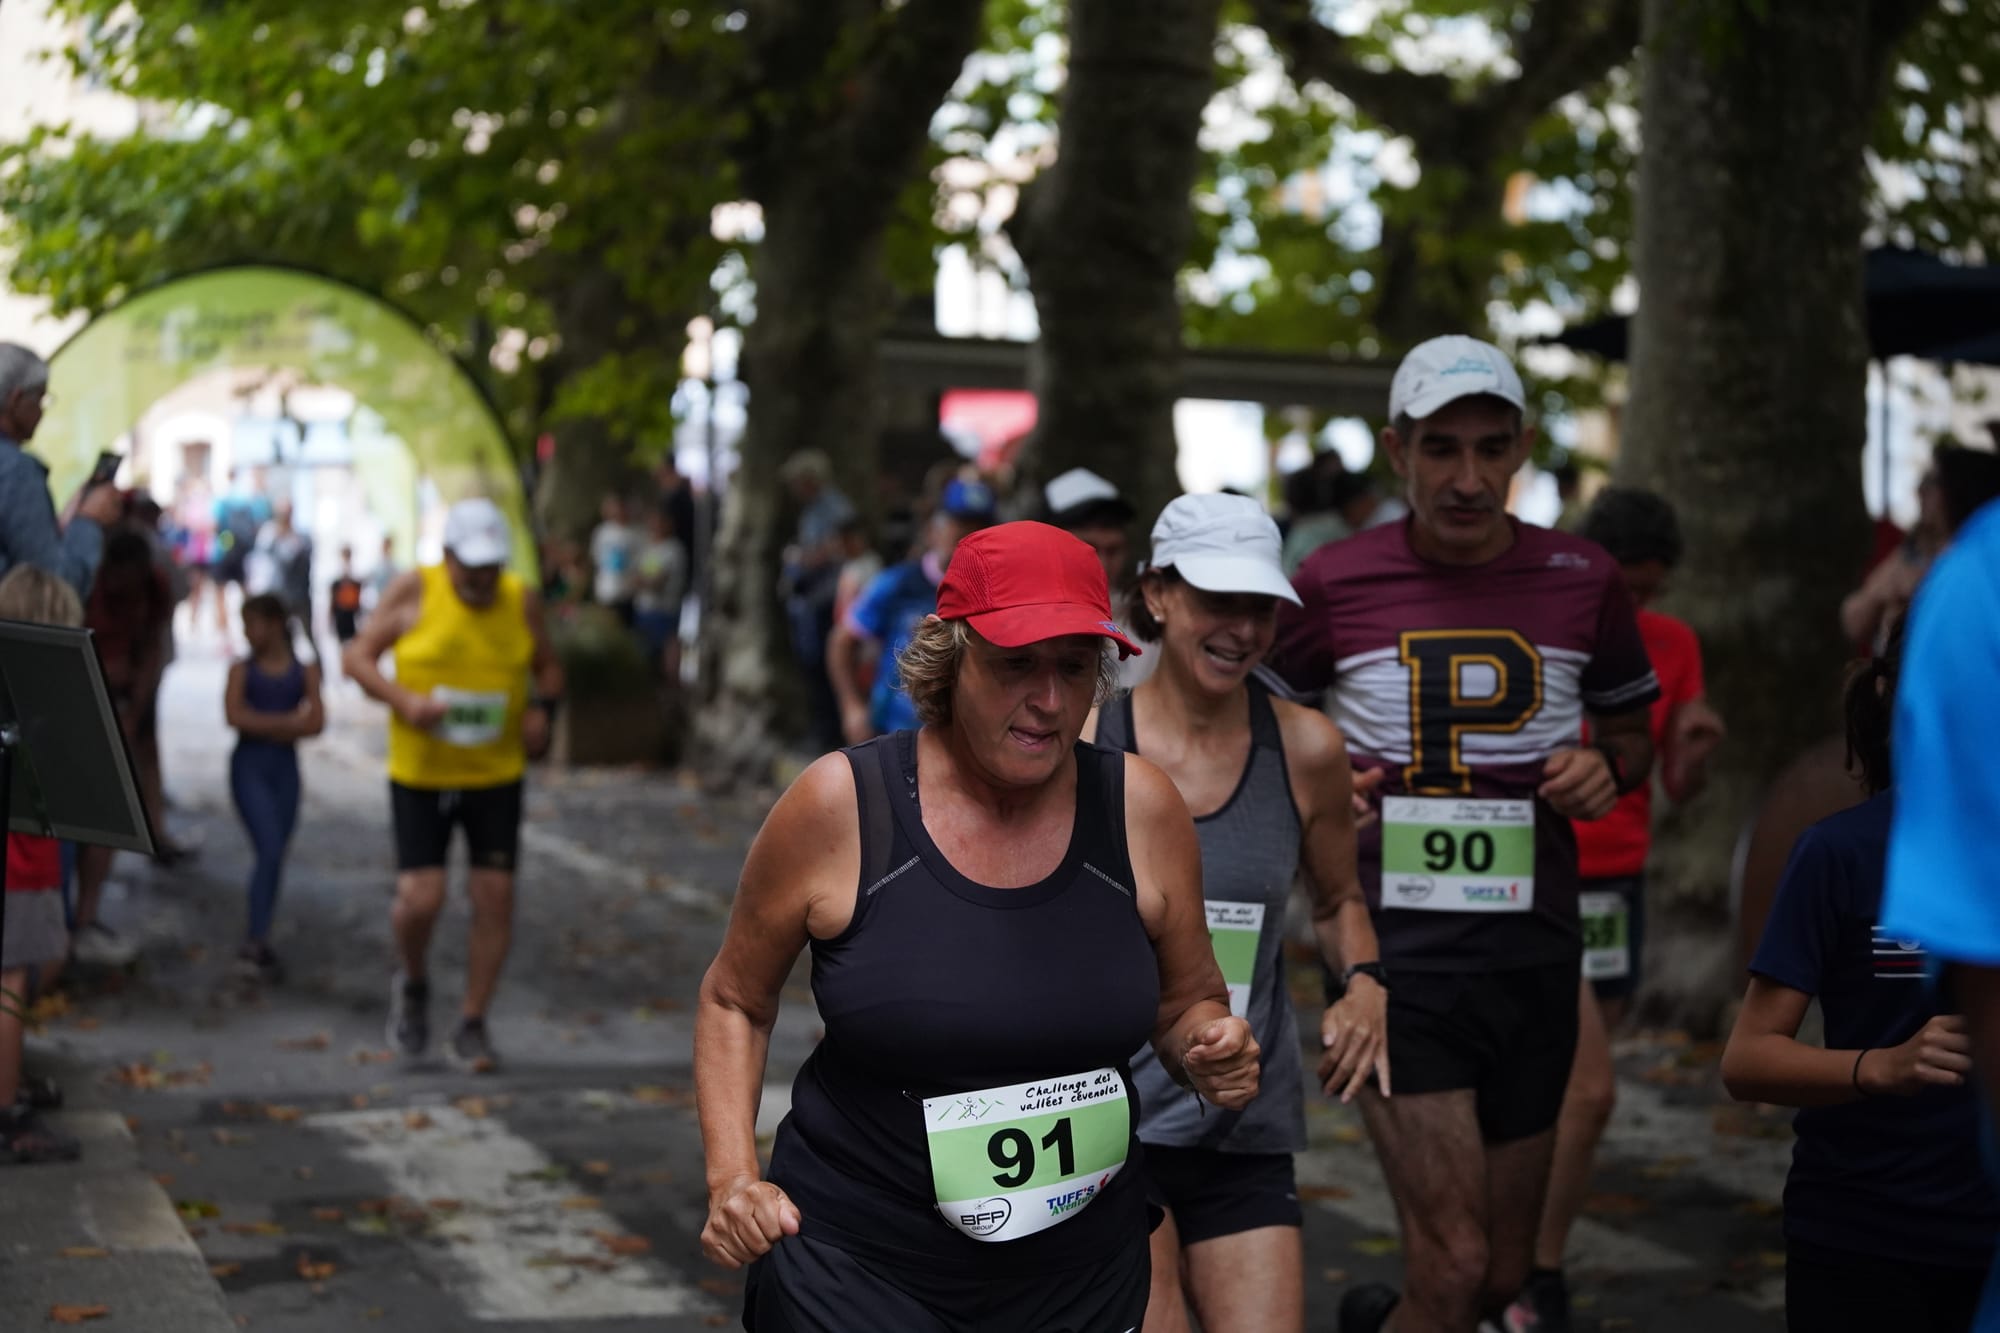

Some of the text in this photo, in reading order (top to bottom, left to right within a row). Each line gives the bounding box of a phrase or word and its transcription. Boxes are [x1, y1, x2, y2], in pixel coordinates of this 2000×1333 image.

[1398, 628, 1543, 796] P
[1423, 829, 1495, 874] 90
[1020, 1084, 1118, 1112] vallées cévenoles
[1025, 1072, 1111, 1098] Challenge des
[987, 1117, 1075, 1188] 91
[1046, 1185, 1095, 1210] TUFF'S
[960, 1210, 1005, 1226] BFP
